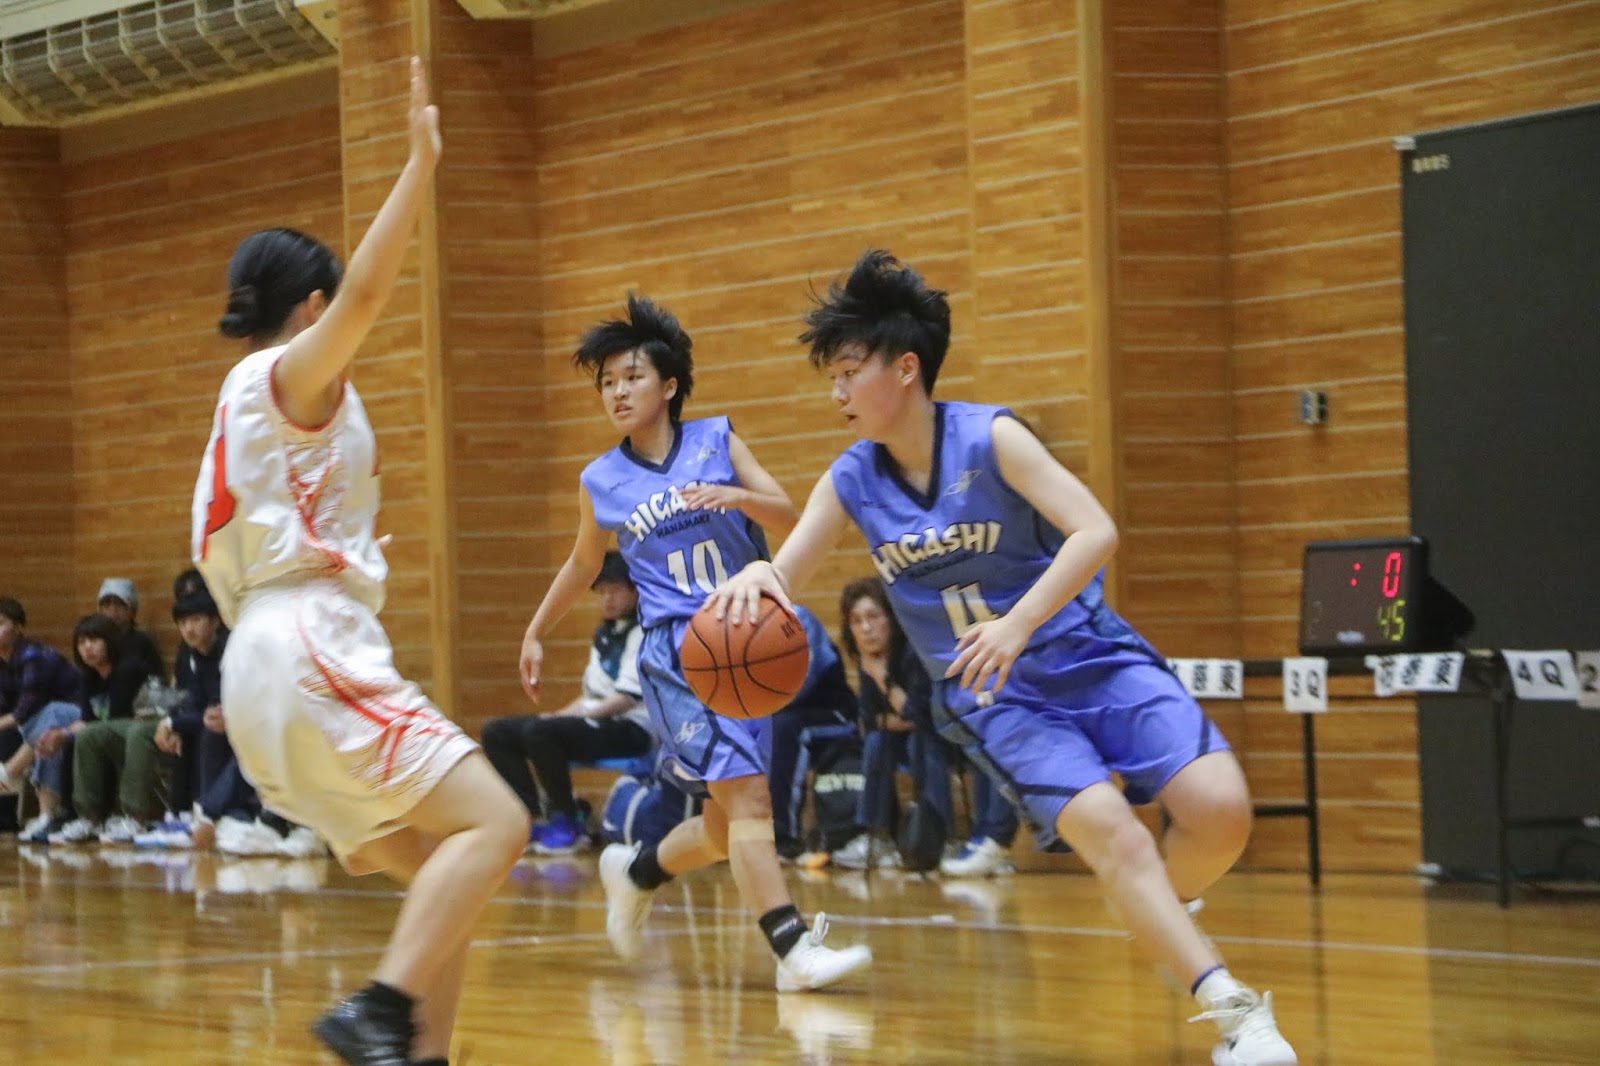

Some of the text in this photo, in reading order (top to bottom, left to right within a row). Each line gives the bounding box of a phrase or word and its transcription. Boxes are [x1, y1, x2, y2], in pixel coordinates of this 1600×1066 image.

[667, 538, 729, 596] 10
[872, 520, 1003, 585] HIGASHI
[1516, 658, 1566, 689] 4Q
